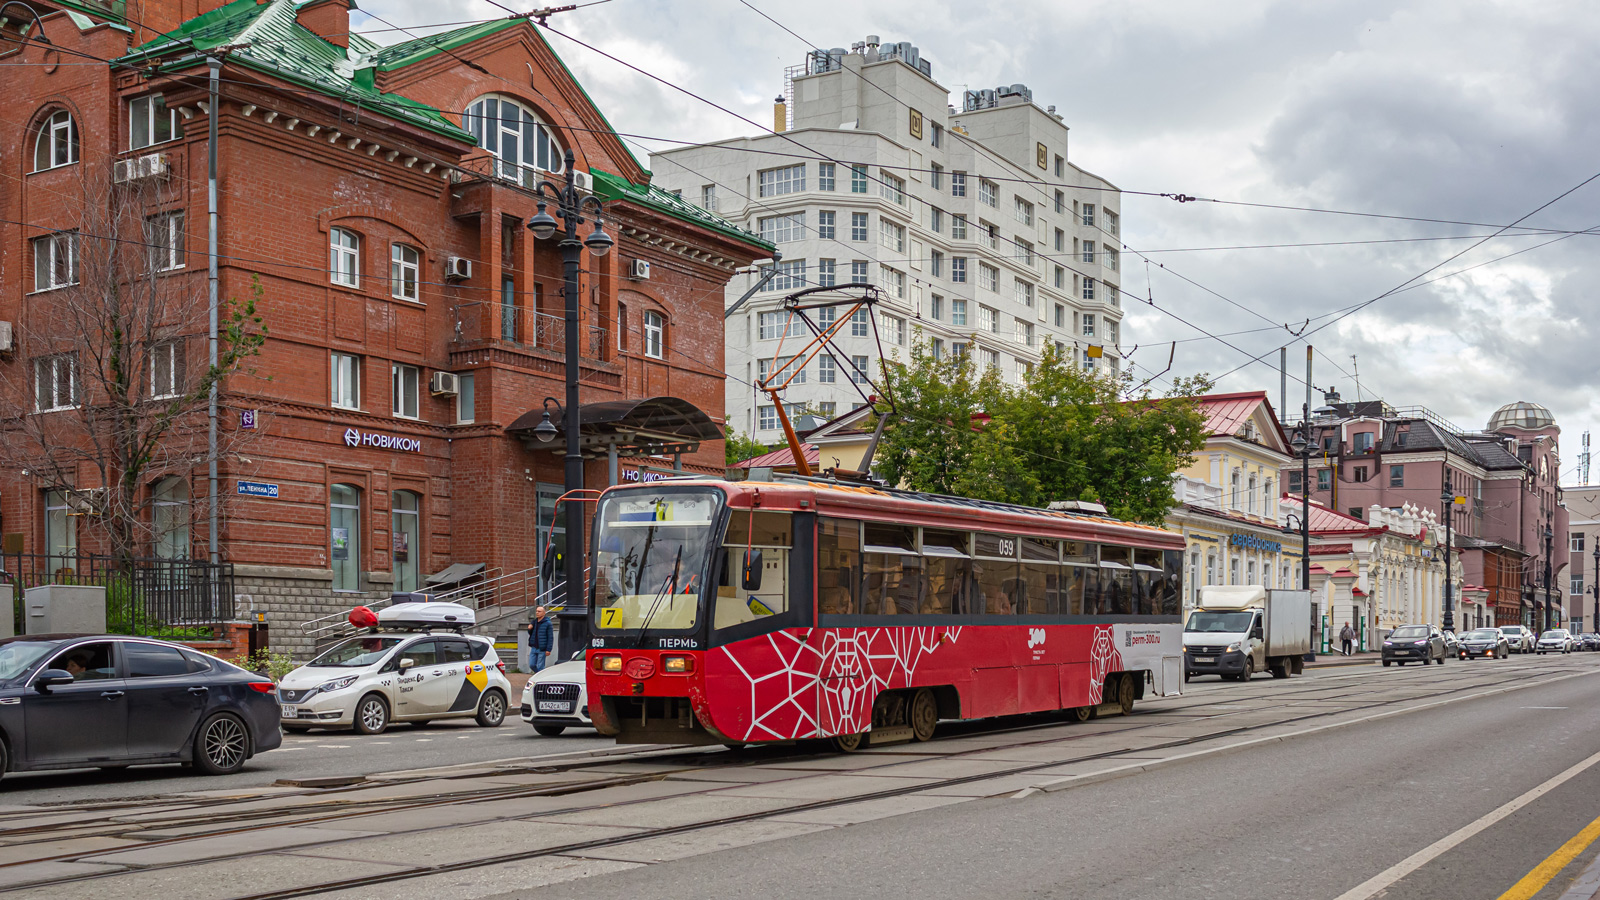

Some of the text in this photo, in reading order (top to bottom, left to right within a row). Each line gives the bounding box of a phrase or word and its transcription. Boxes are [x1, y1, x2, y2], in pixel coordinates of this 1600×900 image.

[363, 432, 420, 452] НОВИКОМ
[269, 486, 278, 495] 20
[998, 539, 1014, 556] 059
[605, 609, 616, 625] 7
[591, 638, 605, 648] 059
[659, 638, 698, 648] ПЕРМЬ
[1132, 634, 1161, 647] perm-300.ru
[397, 676, 416, 685] Яндекс
[399, 686, 414, 694] Такси
